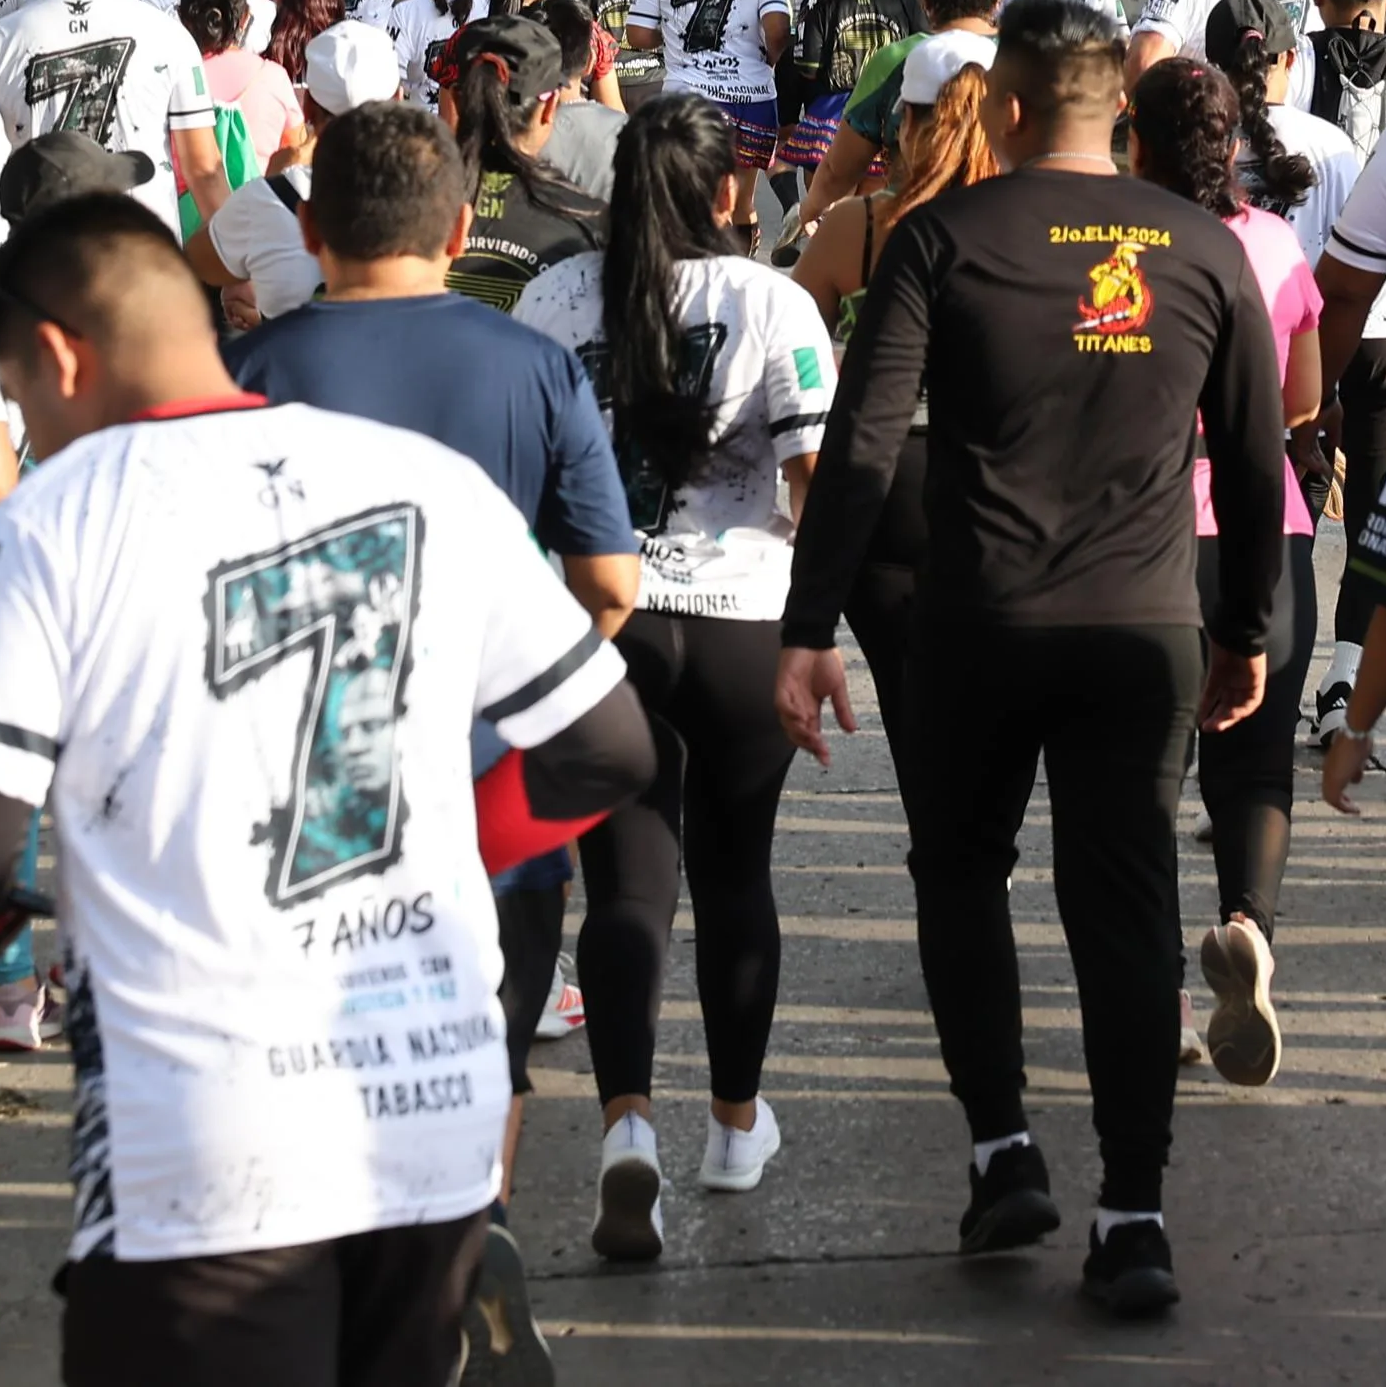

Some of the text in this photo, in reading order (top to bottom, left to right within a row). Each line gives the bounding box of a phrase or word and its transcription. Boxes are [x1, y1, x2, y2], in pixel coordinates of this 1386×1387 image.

[69, 19, 89, 34] GN
[476, 197, 505, 219] GN
[463, 235, 538, 267] SIRVIENDO
[1072, 333, 1154, 354] TITANES
[646, 592, 742, 615] NACIONAL
[204, 503, 426, 911] 7
[292, 890, 435, 957] 7 AÑOS
[267, 1031, 395, 1078] GUARDIA
[356, 1071, 474, 1121] TABASCO
